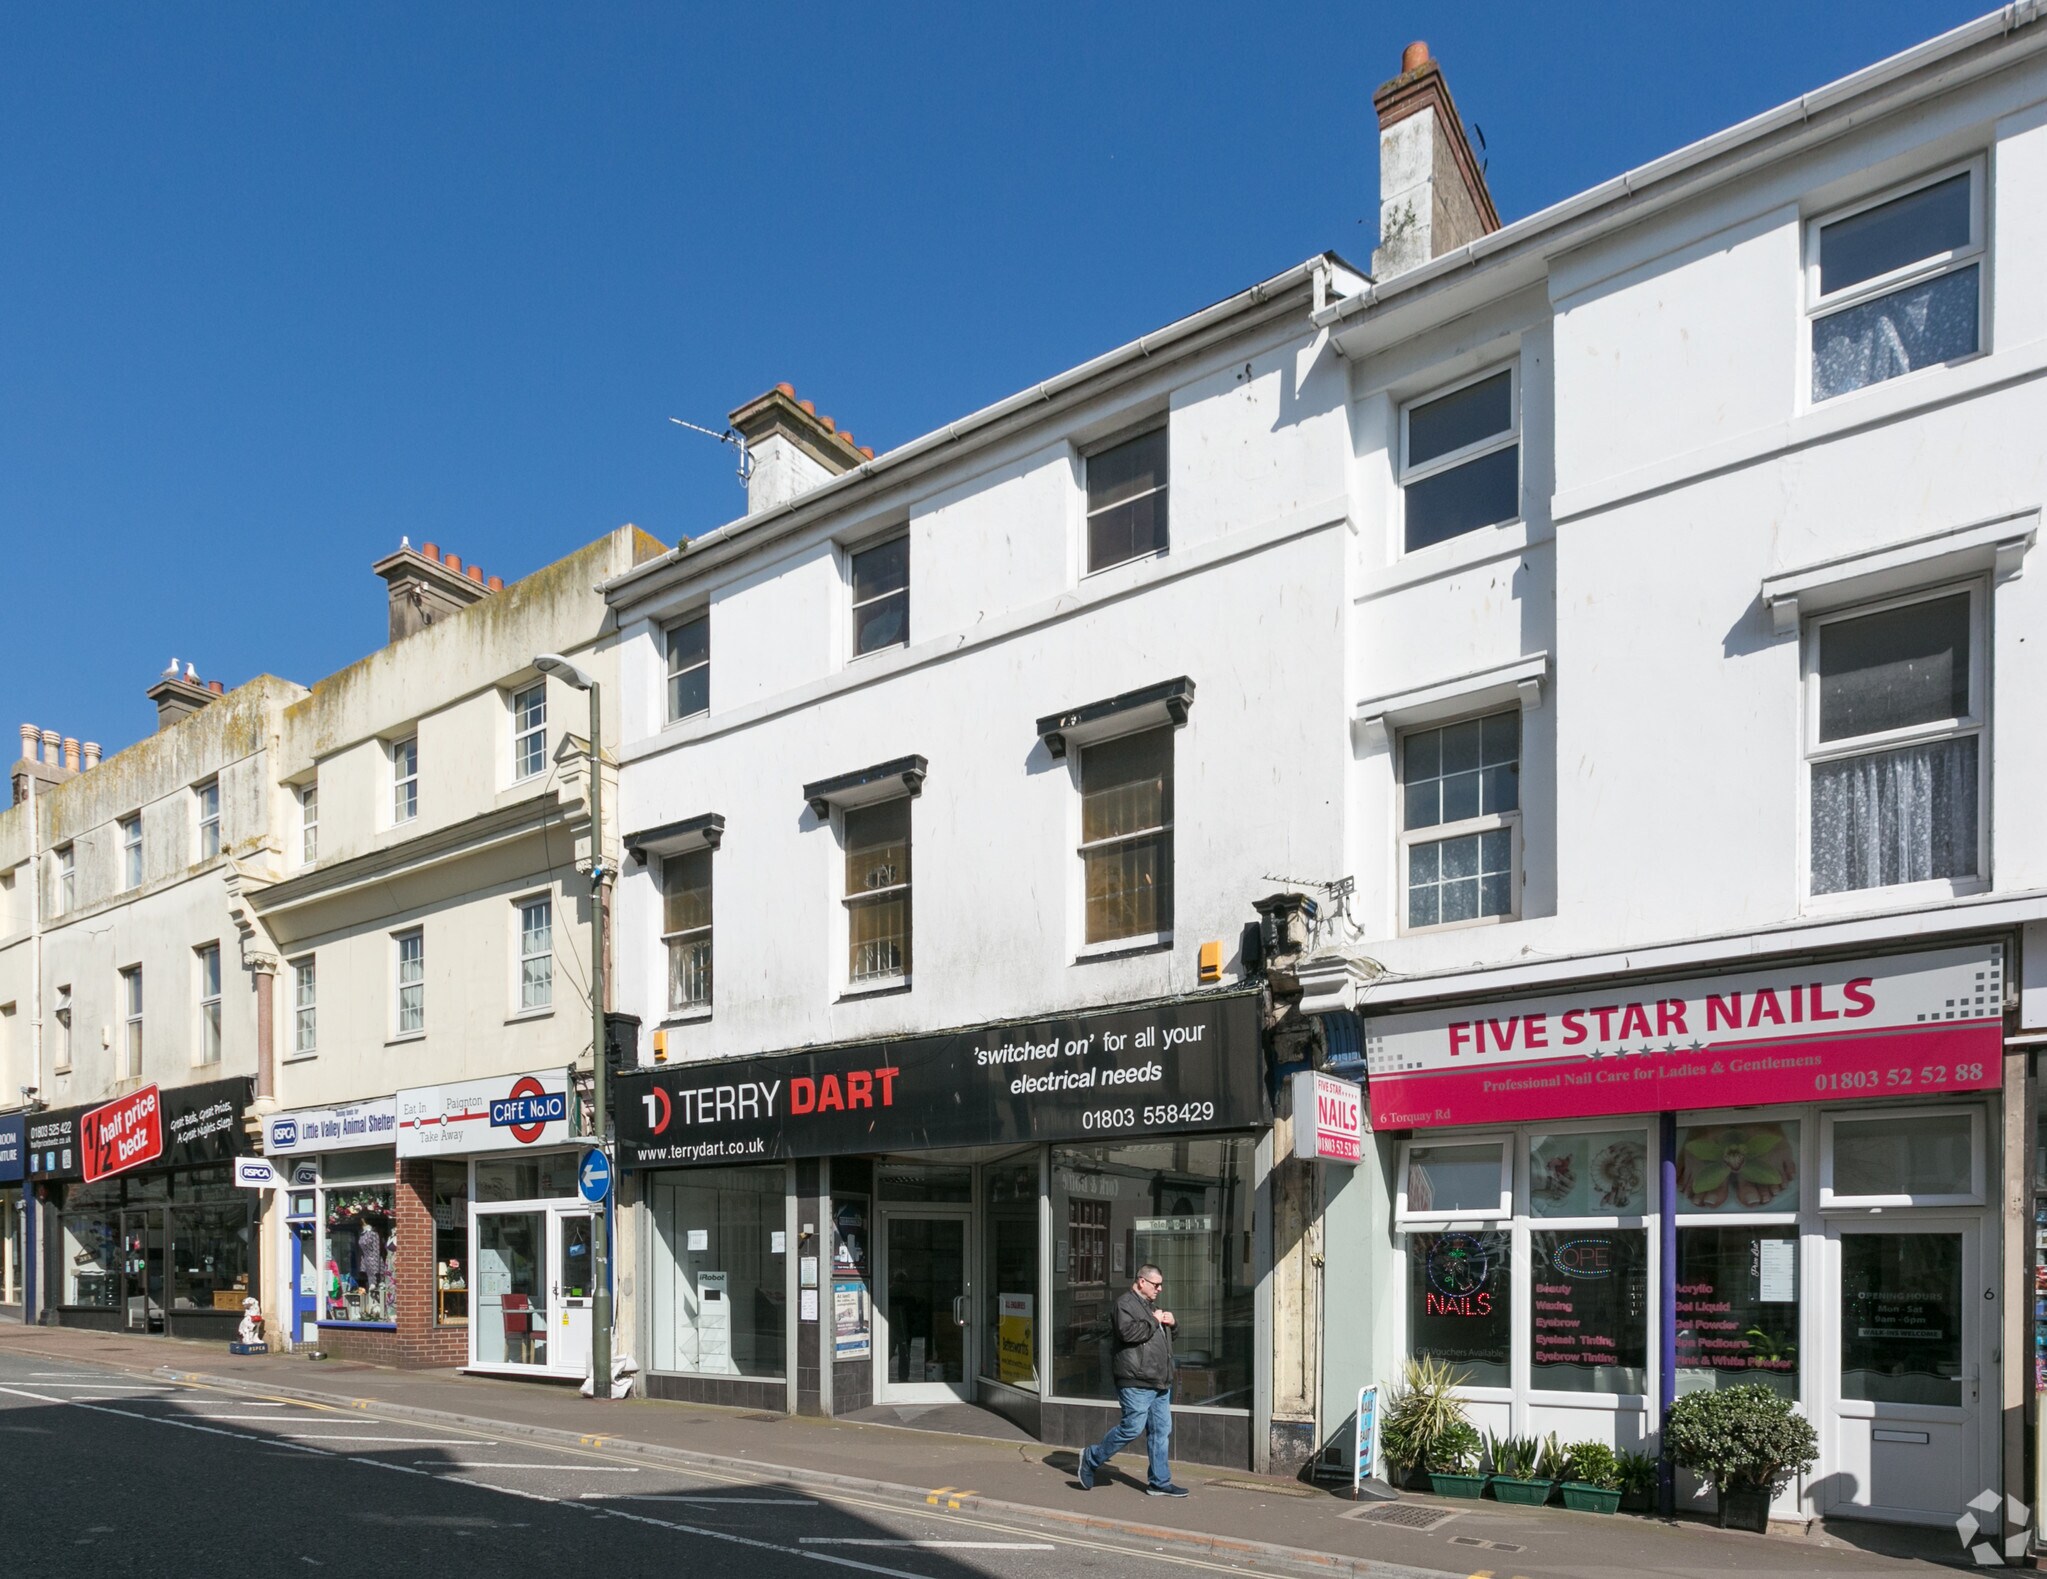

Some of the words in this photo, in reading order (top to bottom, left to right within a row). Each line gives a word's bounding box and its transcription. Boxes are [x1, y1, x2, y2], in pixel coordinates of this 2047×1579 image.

[1448, 1012, 1548, 1056] FIVE
[1561, 998, 1688, 1046] STAR
[1705, 977, 1876, 1032] NAILS
[1102, 1032, 1126, 1051] for
[1134, 1026, 1155, 1048] all
[1162, 1024, 1206, 1050] your
[1010, 1066, 1096, 1094] electrical
[1101, 1061, 1162, 1086] needs
[1483, 1075, 1560, 1092] Professional
[1564, 1072, 1592, 1085] Nail
[1595, 1068, 1630, 1082] Care
[1634, 1066, 1654, 1080] for
[1659, 1062, 1706, 1078] Ladies
[1710, 1060, 1724, 1074] &
[1730, 1055, 1822, 1072] Gentlemens
[1814, 1070, 1879, 1091] 01803
[1886, 1067, 1912, 1086] 52
[1920, 1065, 1948, 1084] 52
[1954, 1062, 1983, 1082] 88
[1318, 1080, 1329, 1092] FIVE
[1330, 1084, 1342, 1096] STAR
[447, 1096, 482, 1111] Paignton
[679, 1080, 781, 1125] TERRY
[790, 1067, 900, 1115] DART
[404, 1104, 416, 1115] Eat
[418, 1102, 427, 1113] In
[493, 1101, 525, 1122] CAFE
[1082, 1108, 1135, 1130] 01803
[1144, 1101, 1215, 1125] 558429
[1318, 1095, 1357, 1132] NAILS
[1380, 1113, 1387, 1124] 6
[1390, 1110, 1432, 1123] Torquay
[1434, 1108, 1451, 1120] Rd
[100, 1112, 122, 1145] half
[124, 1094, 156, 1134] price
[302, 1123, 318, 1140] Little
[321, 1120, 340, 1138] Valley
[343, 1116, 366, 1135] Animal
[368, 1114, 395, 1132] Shelter
[30, 1124, 48, 1139] 01803
[48, 1123, 60, 1136] 525
[60, 1121, 72, 1134] 422
[274, 1126, 295, 1140] RSPCA
[419, 1130, 438, 1143] Take
[441, 1130, 464, 1145] Away
[118, 1128, 148, 1162] bedz
[637, 1138, 764, 1161] www.terrydart.co.uk
[1318, 1136, 1336, 1153] 01803
[1336, 1140, 1344, 1154] 52
[1345, 1141, 1352, 1156] 52
[1352, 1143, 1360, 1158] 88
[244, 1168, 269, 1177] RSPCA
[1536, 1284, 1571, 1295] Beauty
[1858, 1292, 1904, 1300] OPENING
[1906, 1292, 1943, 1300] HOURS
[1984, 1287, 1995, 1300] 6
[1426, 1292, 1492, 1315] NAILS
[1536, 1301, 1572, 1312] Waxing
[1695, 1302, 1731, 1313] Liquid
[1878, 1305, 1900, 1313] Mon
[1536, 1318, 1580, 1328] Eyebrow
[1695, 1320, 1739, 1330] Powder
[1903, 1316, 1926, 1324] 6pm
[1536, 1334, 1575, 1345] Eyelash
[1580, 1336, 1616, 1347] Tinting
[1698, 1338, 1750, 1348] Pedicure
[1431, 1348, 1467, 1357] Vouchers
[1468, 1349, 1504, 1358] Available
[1536, 1351, 1580, 1361] Eyebrow
[1582, 1352, 1618, 1363] Tinting
[1701, 1356, 1710, 1366] &
[1712, 1356, 1746, 1367] White
[1748, 1357, 1792, 1368] Powder
